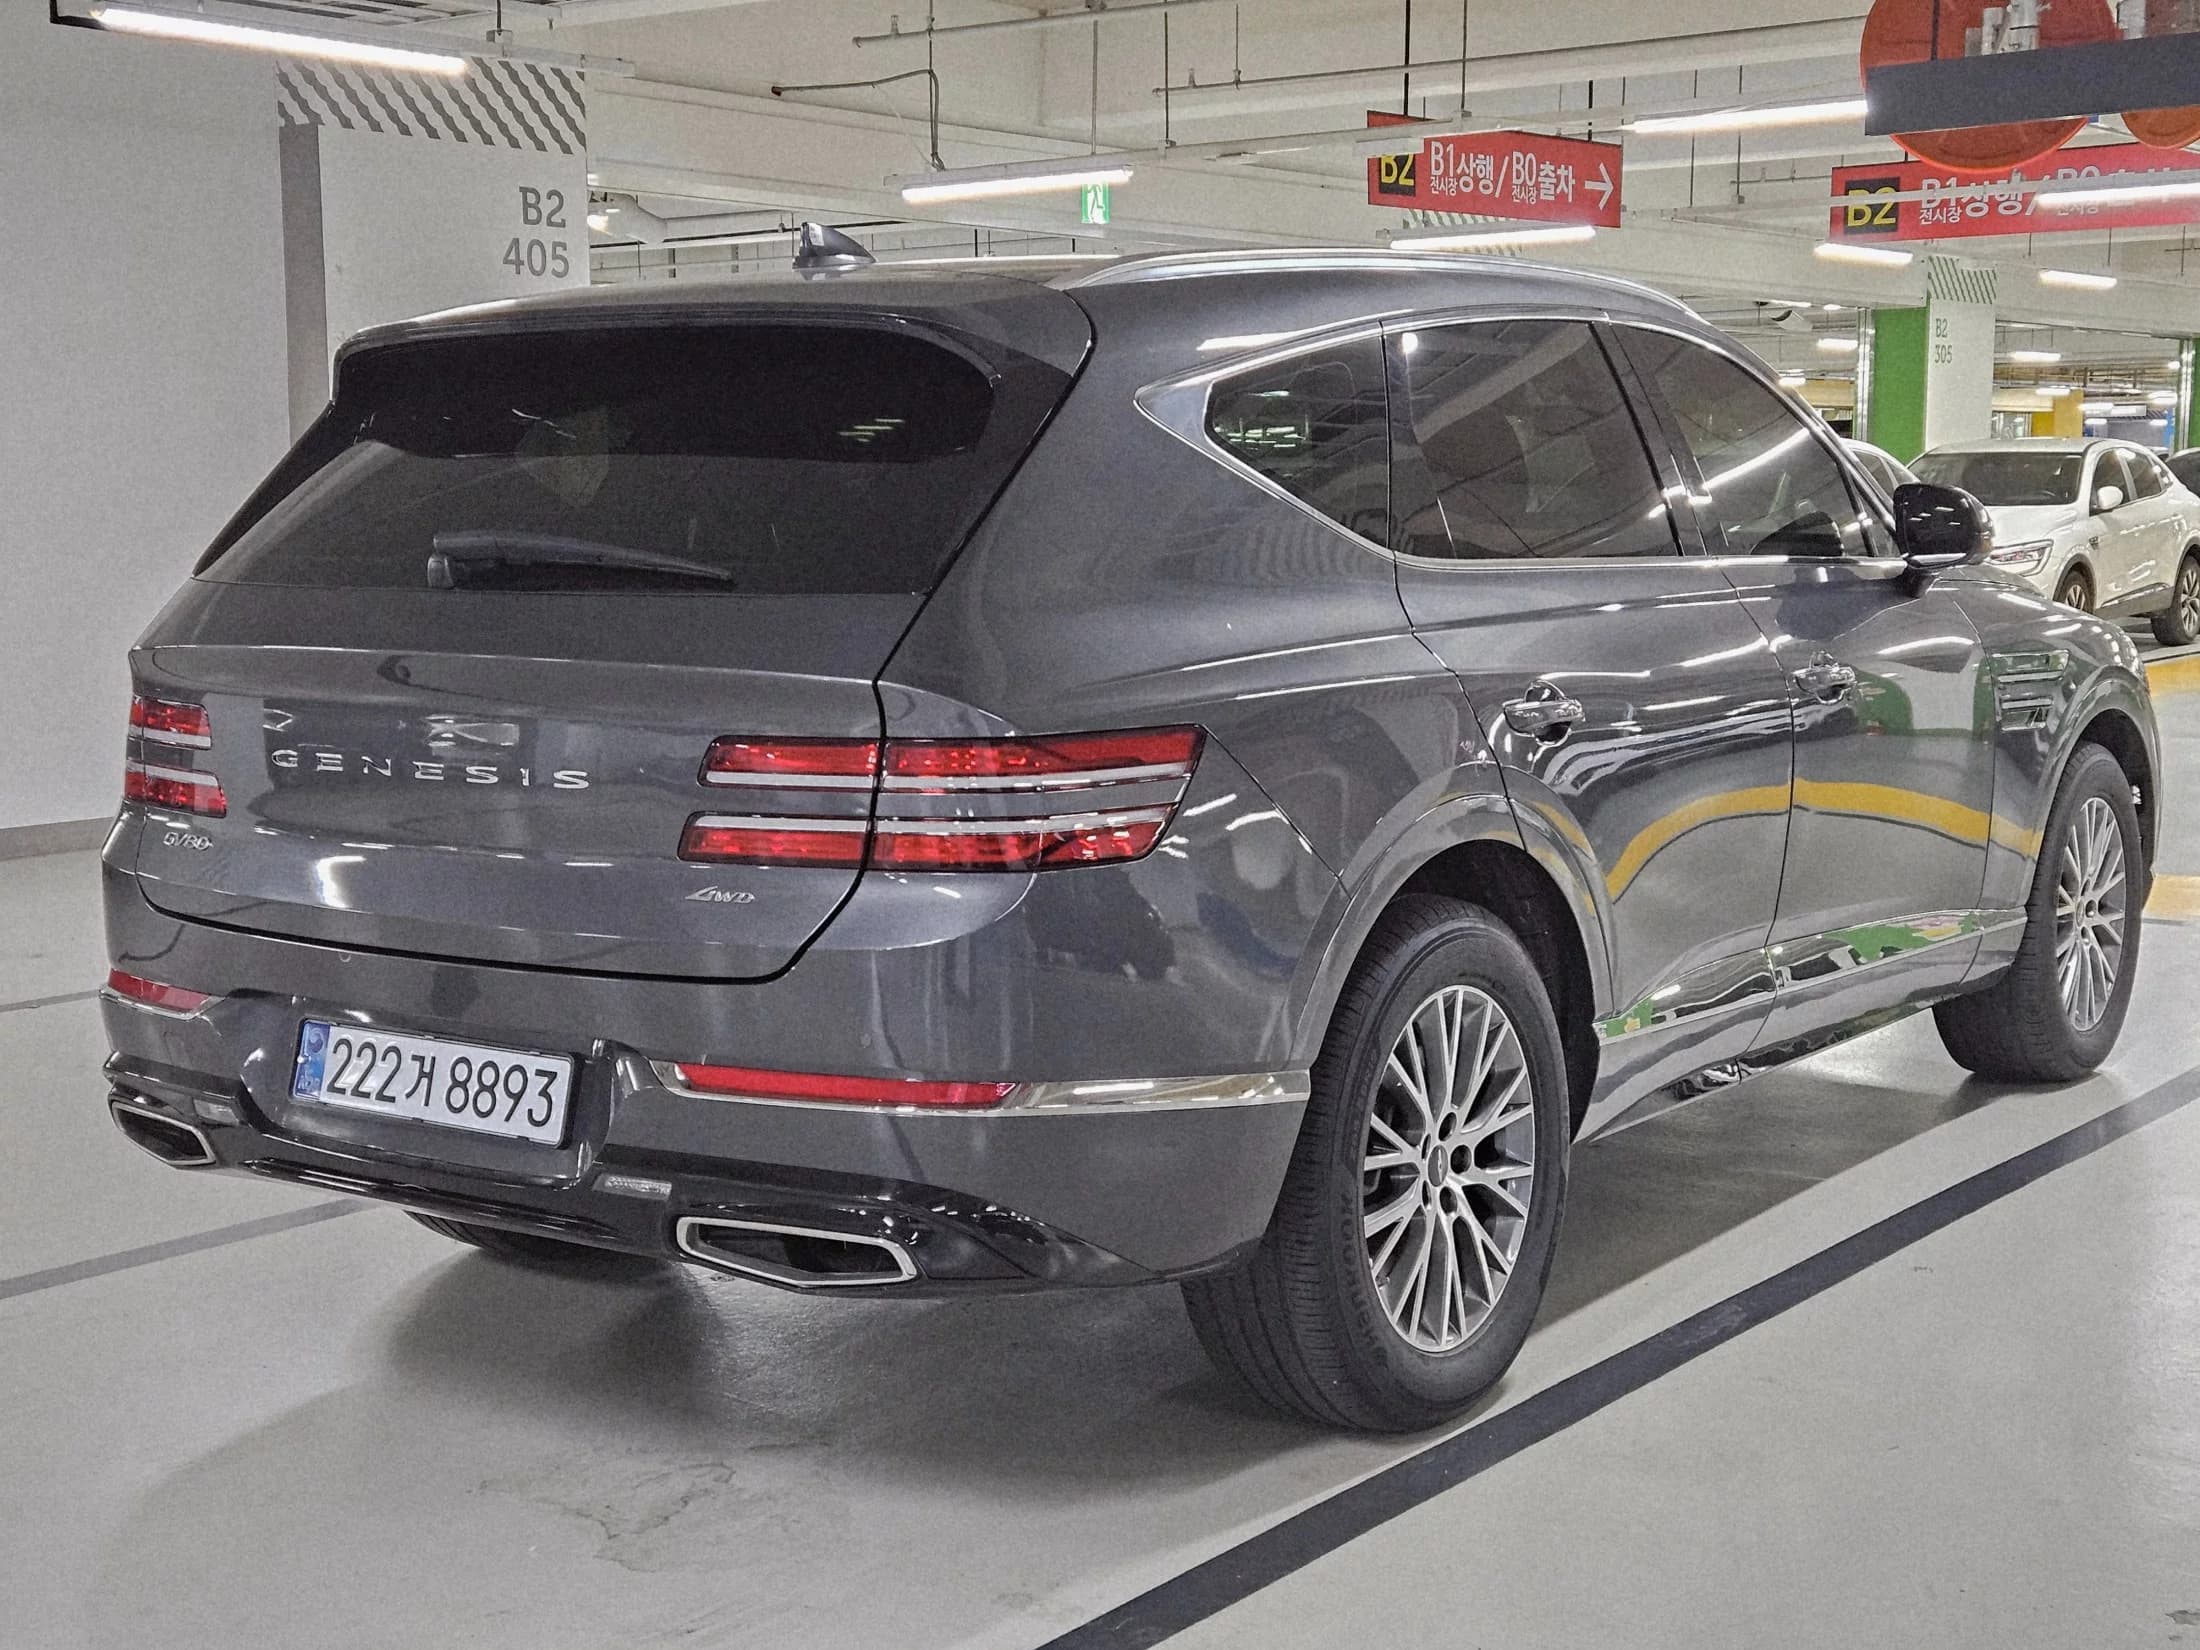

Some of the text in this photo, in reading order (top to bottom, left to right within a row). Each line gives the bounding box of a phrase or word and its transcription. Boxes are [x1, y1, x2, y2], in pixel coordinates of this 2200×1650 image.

[1430, 176, 1458, 197] 전시장
[519, 186, 566, 229] B2
[1919, 206, 1962, 225] 전시장
[502, 237, 570, 278] 405
[1935, 318, 1948, 338] B2
[1934, 344, 1953, 364] 305
[272, 749, 590, 790] GENESIS
